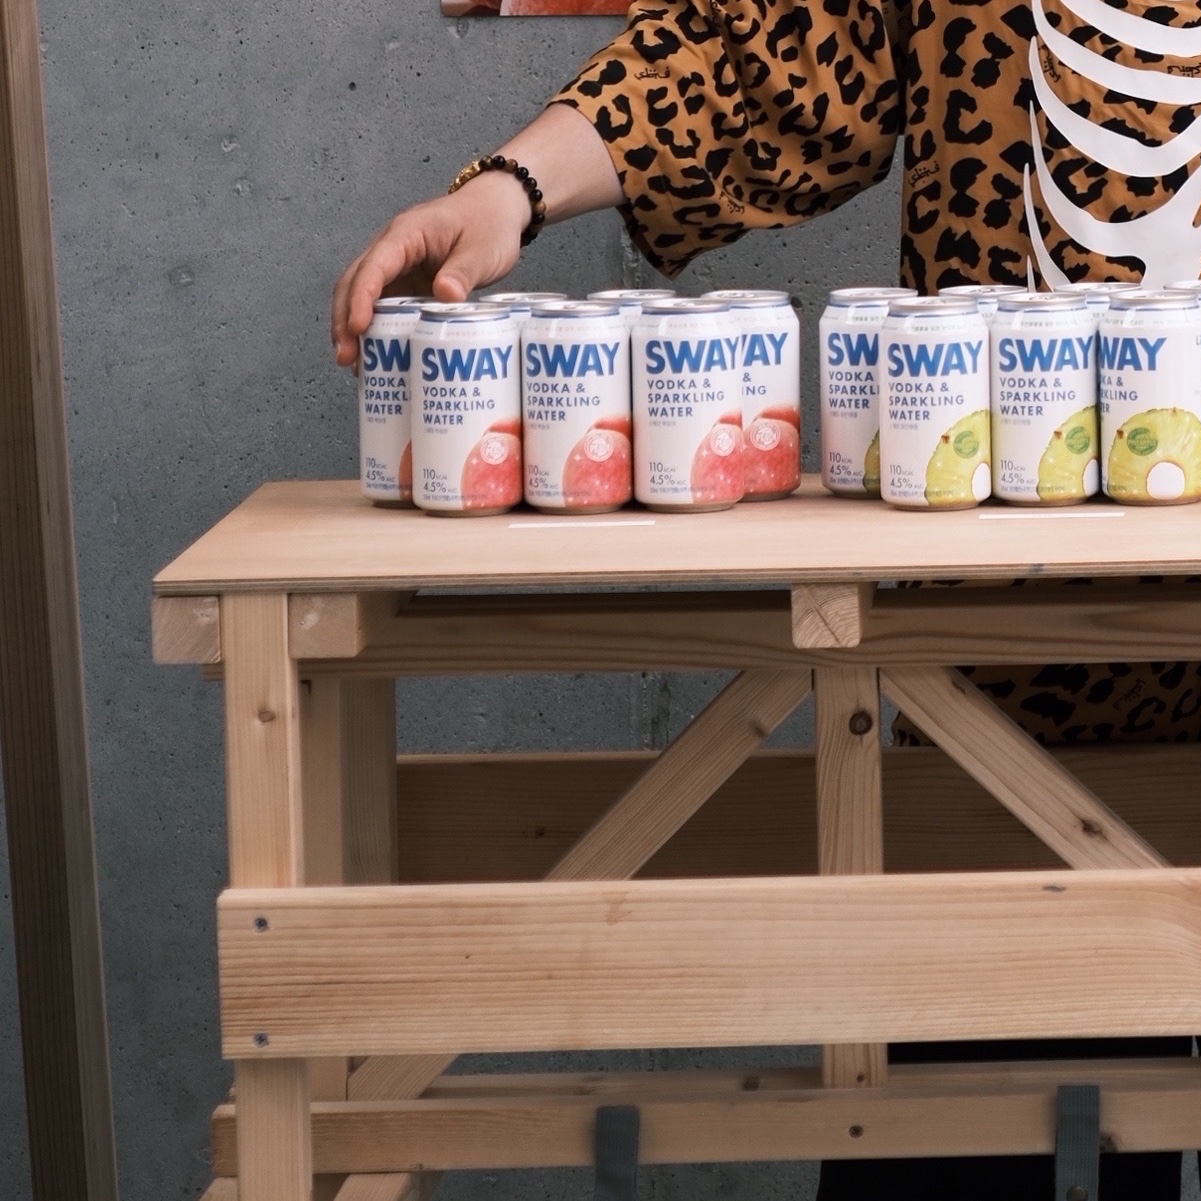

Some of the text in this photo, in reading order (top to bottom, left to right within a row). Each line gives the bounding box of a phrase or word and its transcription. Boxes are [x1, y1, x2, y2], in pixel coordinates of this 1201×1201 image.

[363, 338, 410, 372] SW
[741, 333, 788, 366] AY
[827, 332, 879, 367] SW
[999, 335, 1093, 373] SWAY
[526, 342, 620, 378] SWAY
[646, 336, 739, 375] SWAY
[887, 340, 983, 377] SWAY
[422, 345, 513, 382] SWAY
[743, 372, 751, 383] &
[828, 371, 874, 382] VODKA
[364, 377, 406, 388] VODKA
[527, 382, 585, 393] VODKA &
[647, 378, 711, 390] VODKA &
[888, 382, 949, 393] VODKA &
[999, 377, 1062, 388] VODKA &
[364, 390, 410, 401] SPARKL
[423, 386, 480, 398] VODKA &
[829, 384, 880, 396] SPARKLI
[527, 395, 600, 407] SPARKLING
[647, 391, 724, 403] SPARKLING
[889, 395, 964, 407] SPARKLING
[1000, 390, 1076, 402] SPARKLING
[423, 400, 495, 411] SPARKLING
[829, 398, 870, 409] WATER
[365, 404, 402, 415] WATER
[527, 409, 566, 421] WATER
[648, 407, 693, 417] WATER
[1000, 405, 1044, 416] WATER
[423, 414, 463, 425] WATER
[889, 410, 930, 421] WATER
[829, 465, 851, 476] 4.5%
[650, 475, 675, 485] 4.5%
[1001, 473, 1025, 484] 4.5%
[423, 482, 447, 493] 4.5%
